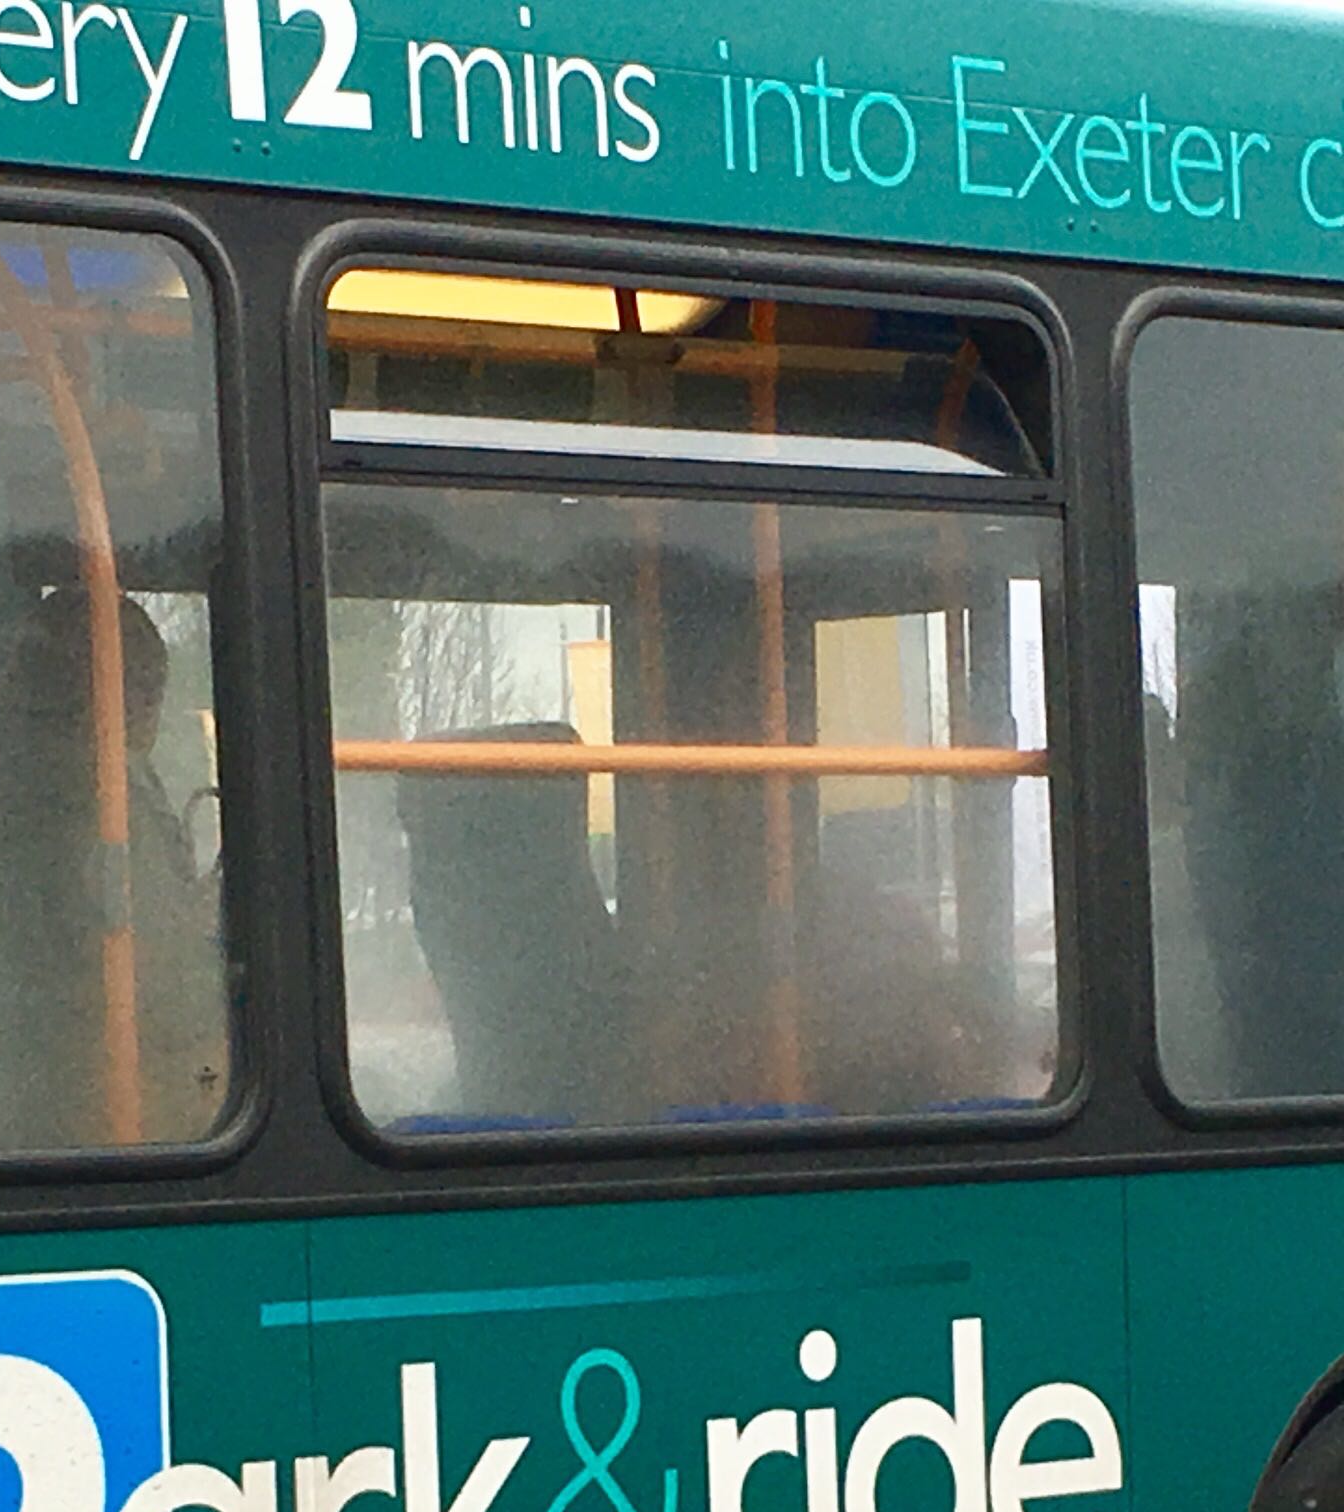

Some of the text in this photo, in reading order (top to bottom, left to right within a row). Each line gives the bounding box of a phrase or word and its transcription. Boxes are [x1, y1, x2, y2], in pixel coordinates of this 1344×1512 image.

[223, 0, 373, 130] 12
[408, 5, 661, 163] mins
[717, 39, 916, 188] into
[951, 54, 1270, 221] Exeter
